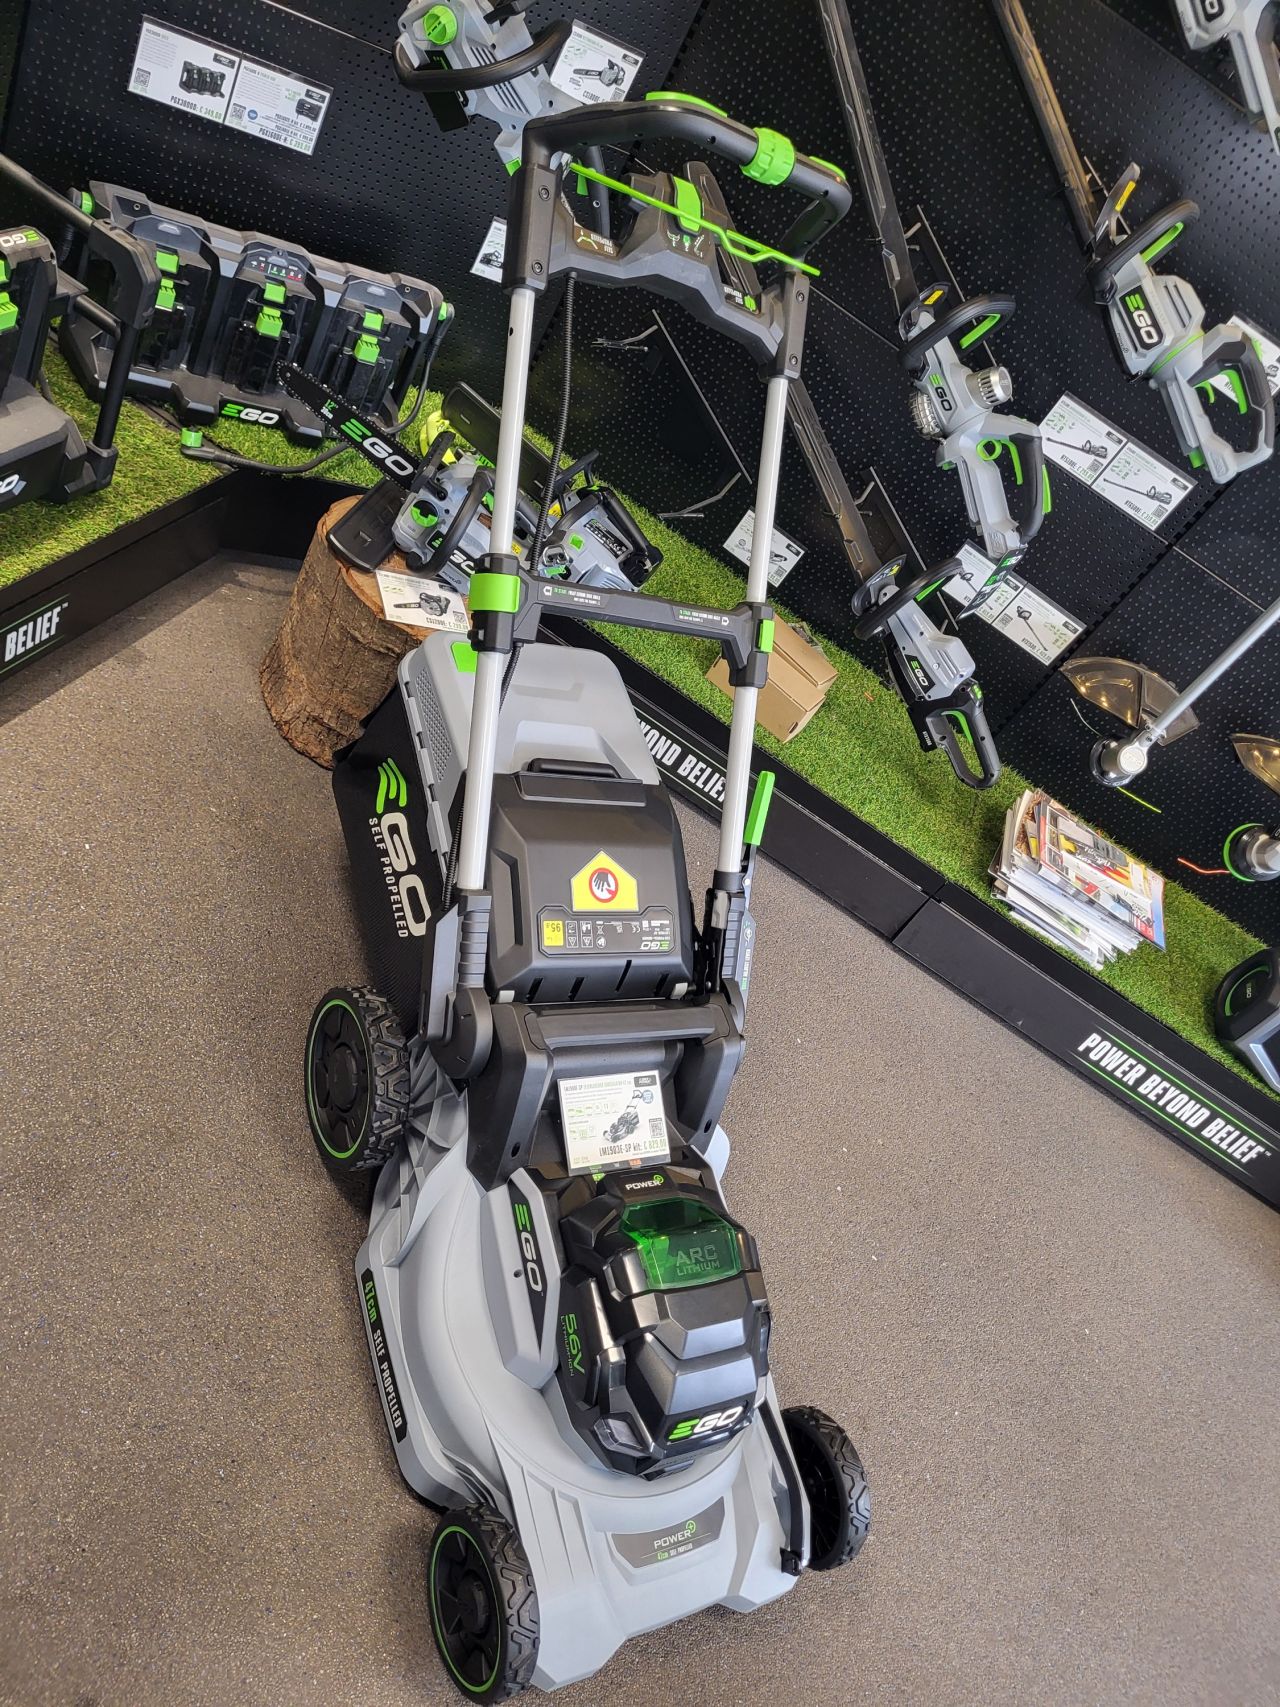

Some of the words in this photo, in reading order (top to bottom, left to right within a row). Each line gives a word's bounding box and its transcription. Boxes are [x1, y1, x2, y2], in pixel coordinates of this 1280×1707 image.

[0, 231, 40, 247] EGO
[1125, 293, 1159, 344] EGO
[221, 403, 279, 425] EGO
[929, 374, 953, 411] EGO
[340, 418, 414, 476] EGO
[910, 660, 929, 686] EGO
[677, 754, 727, 802] BELIE
[376, 757, 432, 937] EGO
[369, 818, 386, 851] SELF
[380, 857, 408, 938] PROPELLED
[640, 941, 670, 950] EGO
[1078, 1032, 1147, 1086] POWER
[1137, 1074, 1211, 1128] BEYOND
[515, 1203, 543, 1293] EGO
[676, 1245, 717, 1267] ARC
[676, 1261, 721, 1276] LITHIUM
[364, 1281, 378, 1323] 47cm
[373, 1329, 386, 1358] SELF
[380, 1361, 403, 1429] PROPELLED
[565, 1313, 586, 1375] 56V
[668, 1405, 744, 1440] EGO
